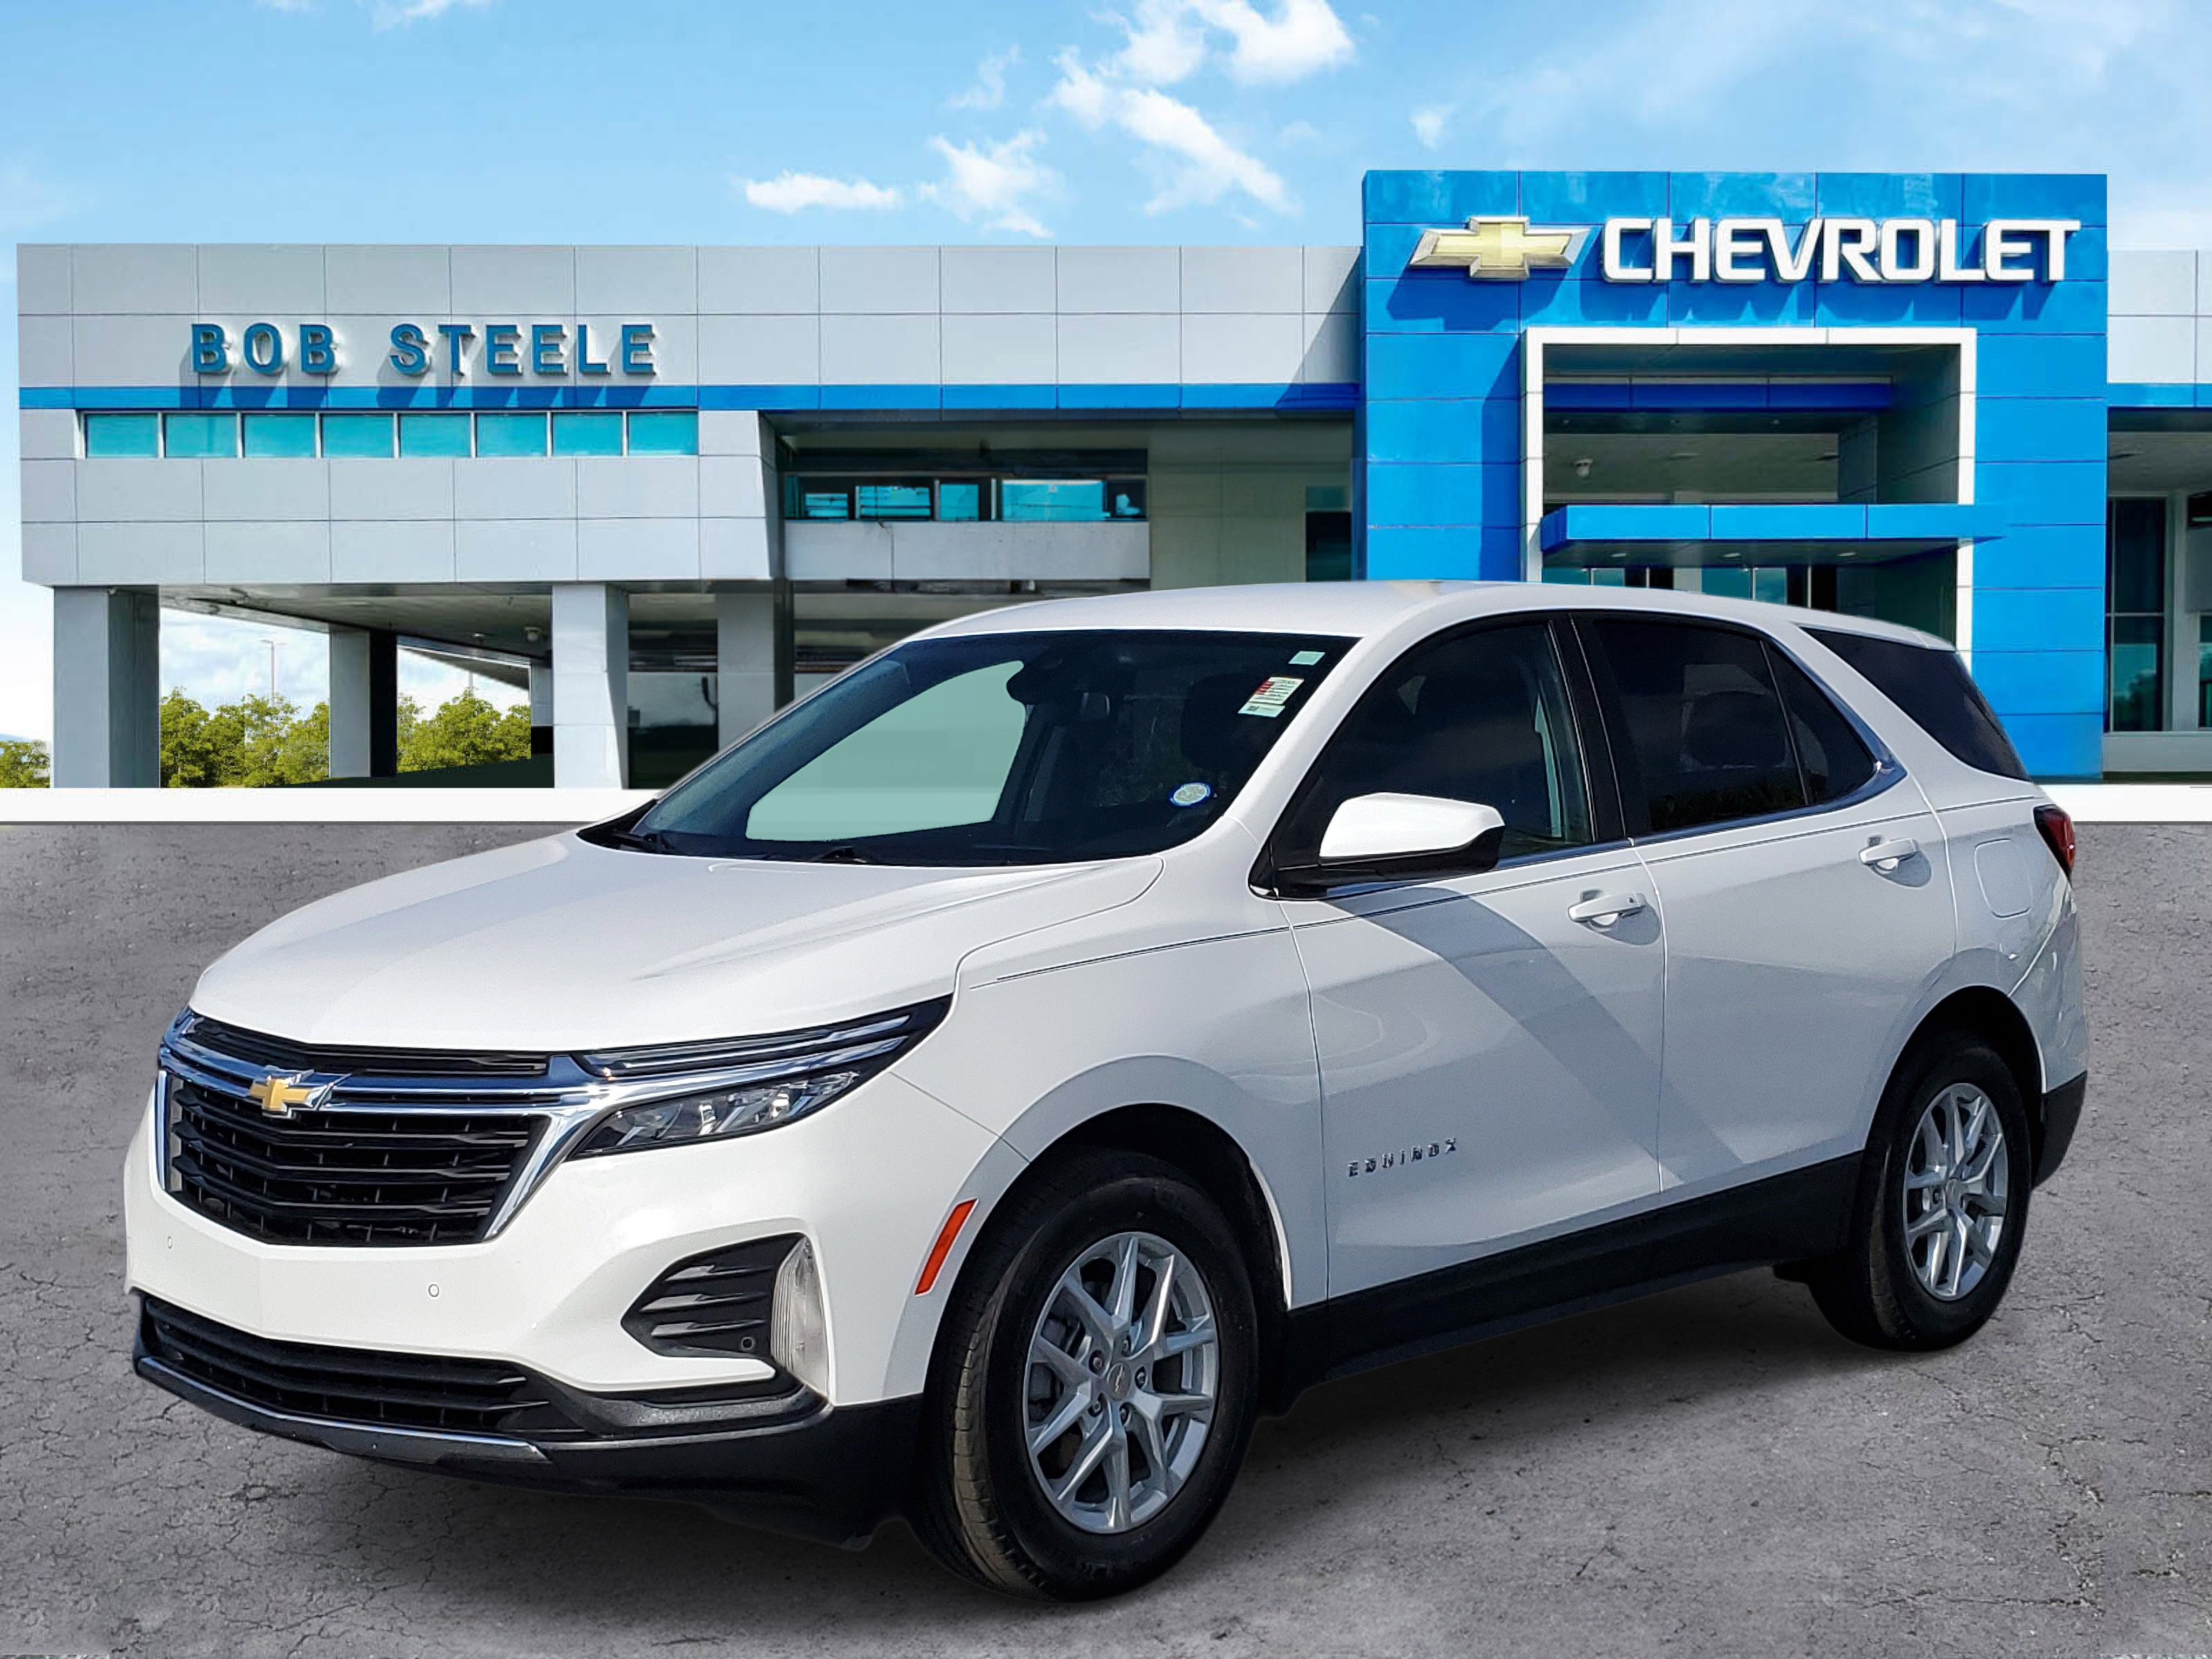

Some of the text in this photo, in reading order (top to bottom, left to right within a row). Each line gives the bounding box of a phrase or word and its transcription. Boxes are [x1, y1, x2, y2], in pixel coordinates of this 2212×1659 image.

[1602, 217, 2081, 282] CHEVROLET
[191, 323, 657, 376] BOB STEELE
[1348, 1137, 1457, 1177] EQUINOX
